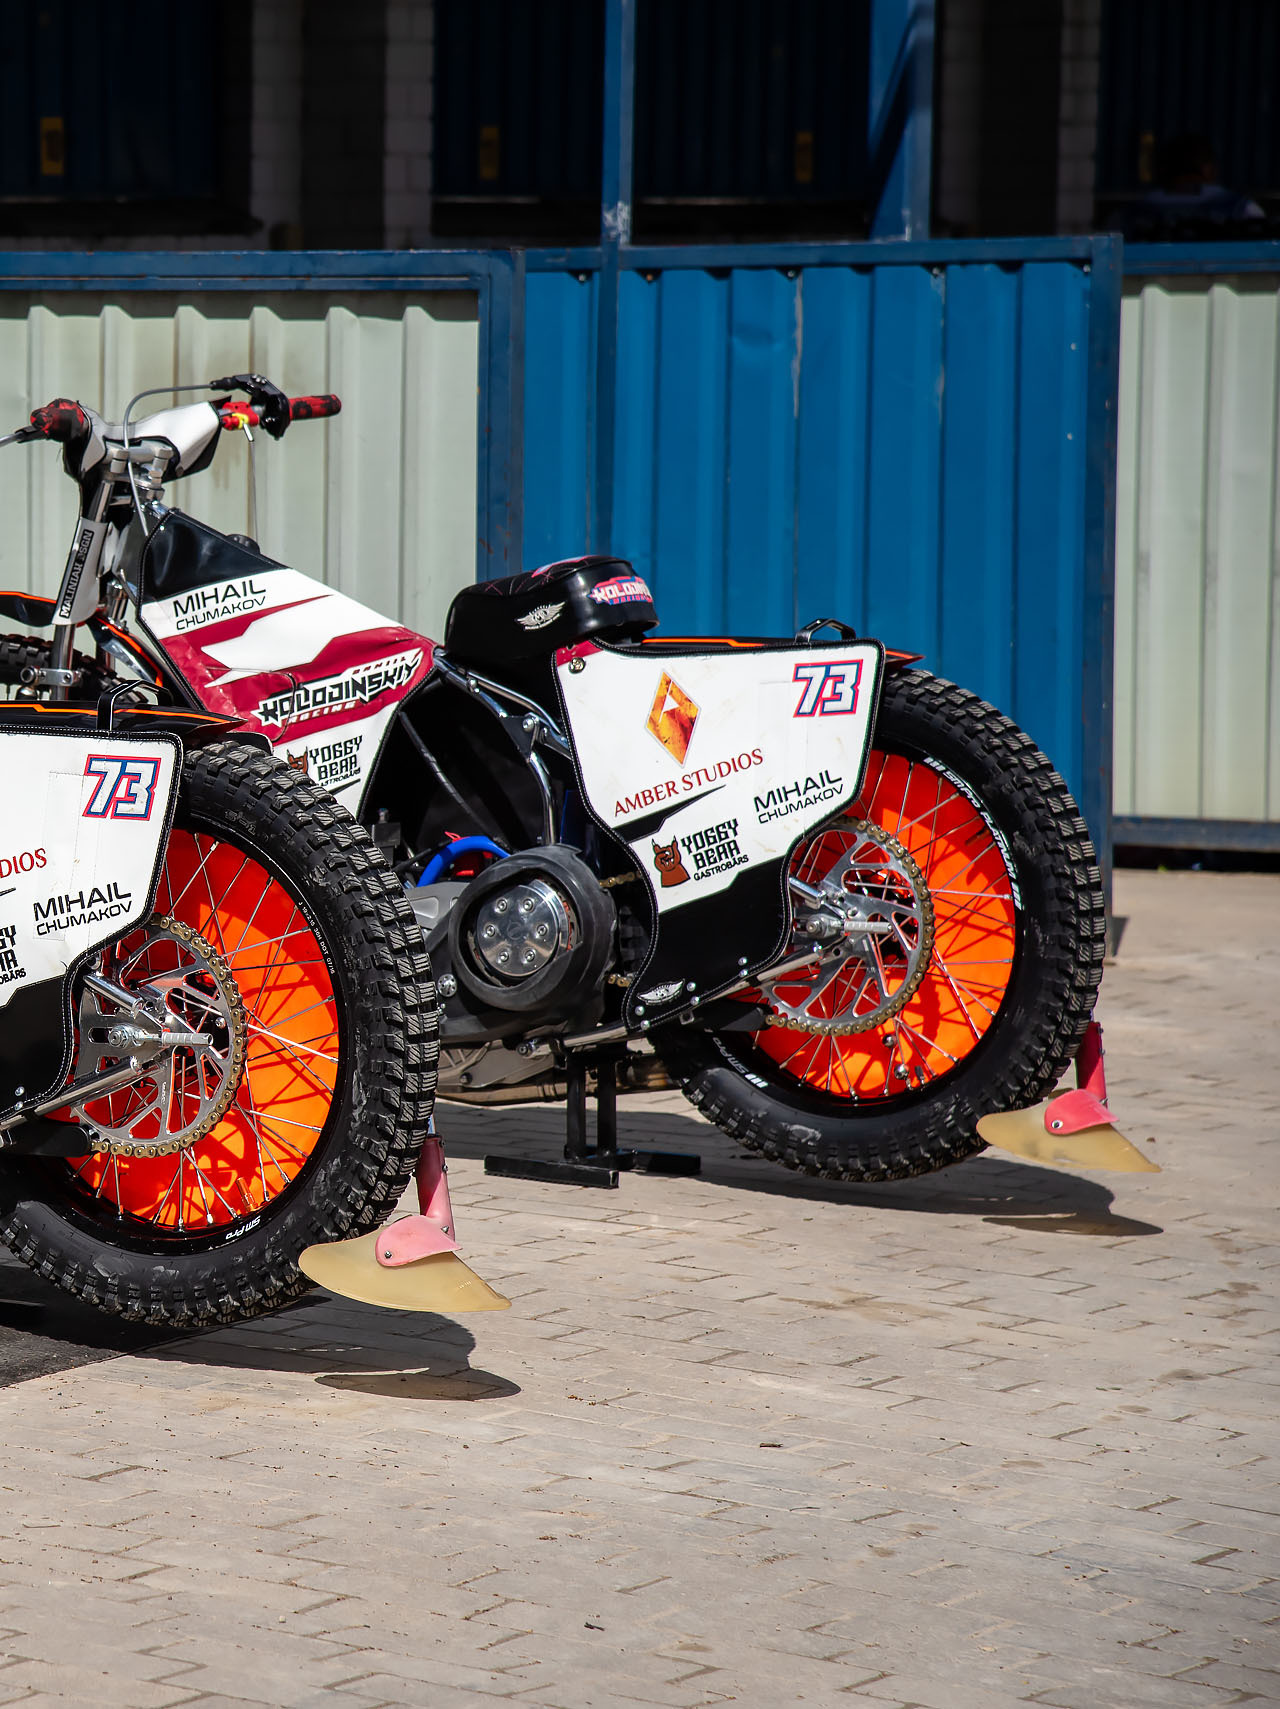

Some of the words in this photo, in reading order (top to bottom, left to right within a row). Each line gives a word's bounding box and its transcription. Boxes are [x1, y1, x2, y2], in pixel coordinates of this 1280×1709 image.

[173, 579, 266, 618] MIHAIL
[175, 596, 266, 631] CHUMAKOV
[792, 659, 863, 718] 73
[309, 735, 363, 765] YOGGY
[317, 754, 358, 781] BEAR
[82, 754, 162, 821] 73
[614, 780, 679, 818] AMBER
[681, 748, 764, 792] STUDIOS
[753, 769, 843, 813] MIHAIL
[758, 783, 844, 824] CHUMAKOV
[681, 818, 739, 856] YOGGY
[693, 839, 741, 871] BEAR
[33, 882, 132, 922] MIHAIL
[36, 900, 132, 936] CHUMAKOV
[320, 941, 329, 955] DOT
